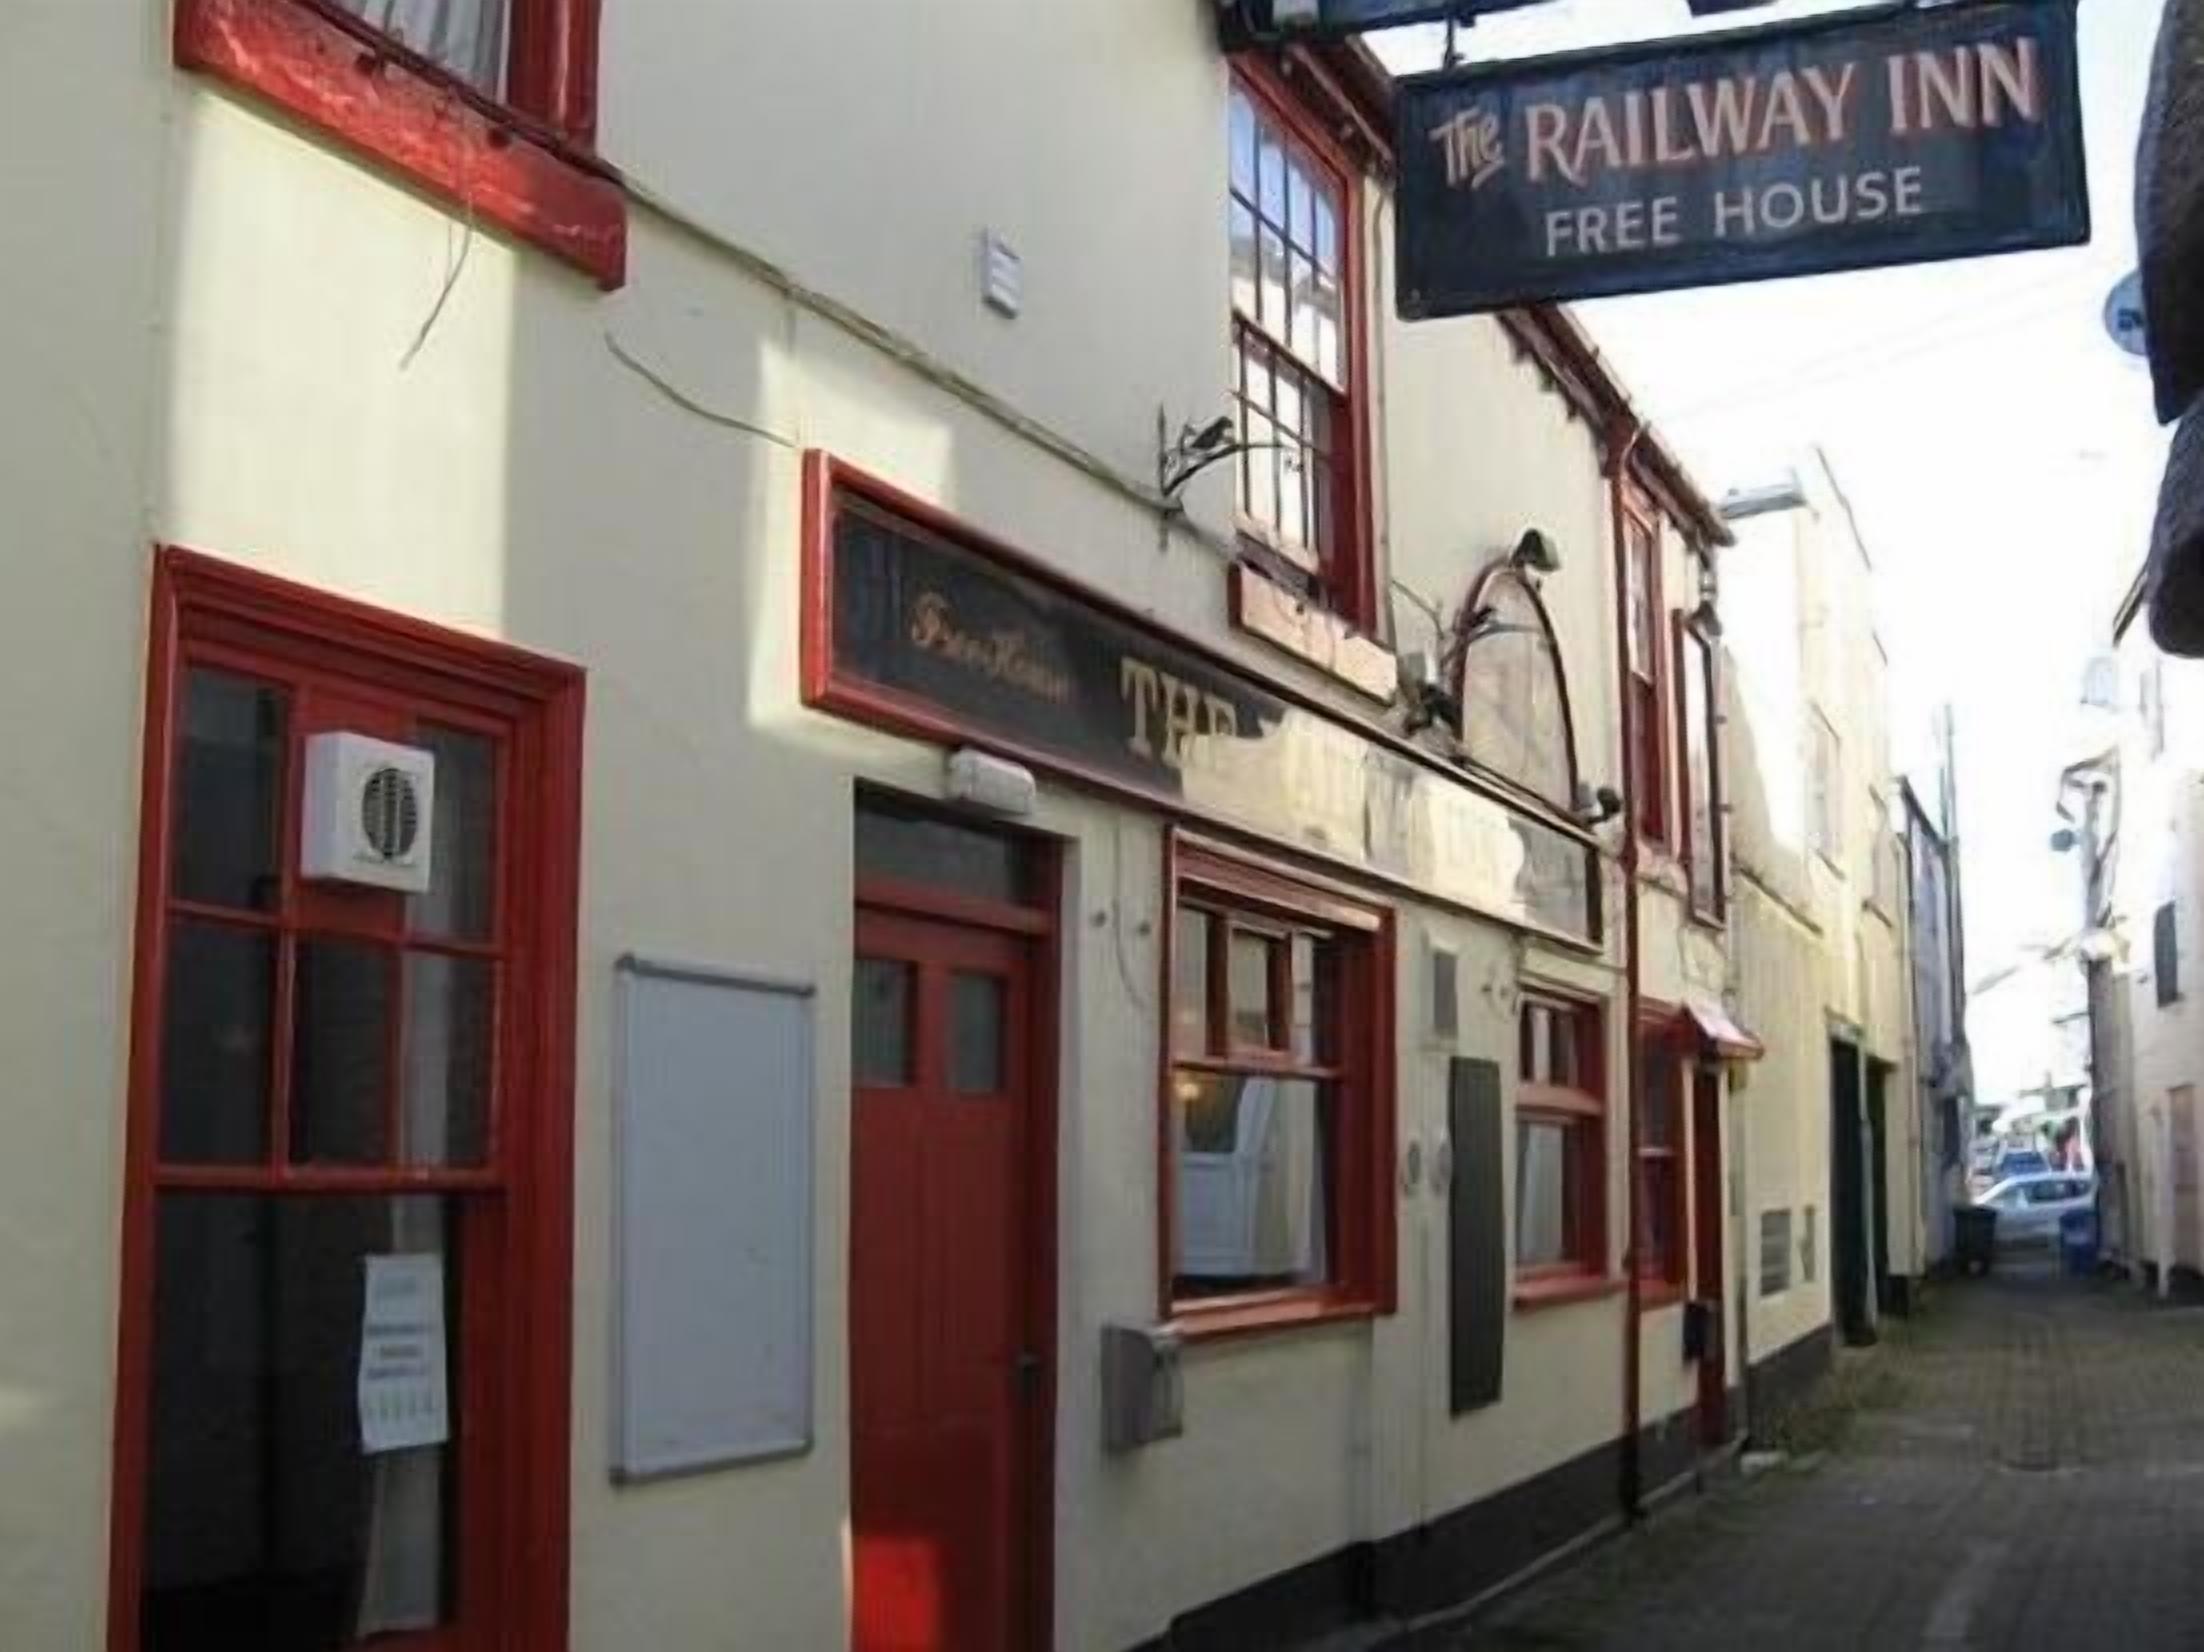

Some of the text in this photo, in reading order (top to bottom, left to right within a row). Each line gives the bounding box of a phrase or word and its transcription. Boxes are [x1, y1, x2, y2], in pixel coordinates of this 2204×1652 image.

[1429, 36, 2038, 189] The RAILWAY INN
[1546, 165, 1922, 258] FREE HOUSE
